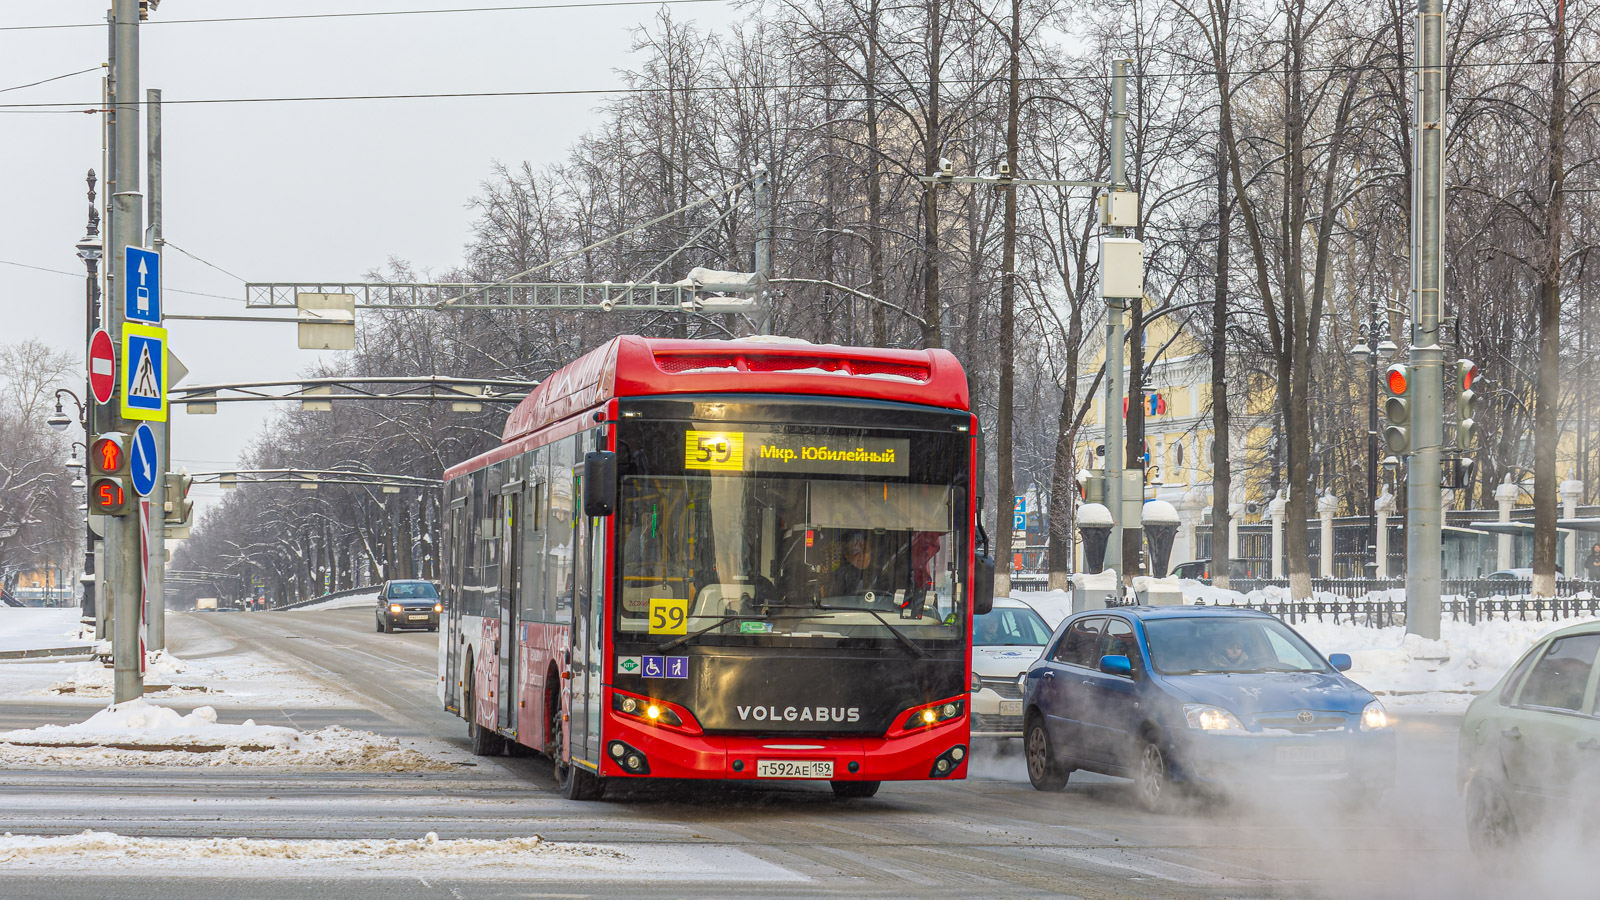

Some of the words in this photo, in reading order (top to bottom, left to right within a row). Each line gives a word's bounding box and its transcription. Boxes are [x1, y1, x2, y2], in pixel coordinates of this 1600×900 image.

[695, 437, 732, 463] 59
[760, 444, 798, 463] Мкр.
[801, 446, 895, 463] Юбилейный
[100, 485, 124, 506] 51
[652, 606, 684, 629] 59
[736, 705, 860, 722] VOLGABUS
[812, 762, 831, 773] 159
